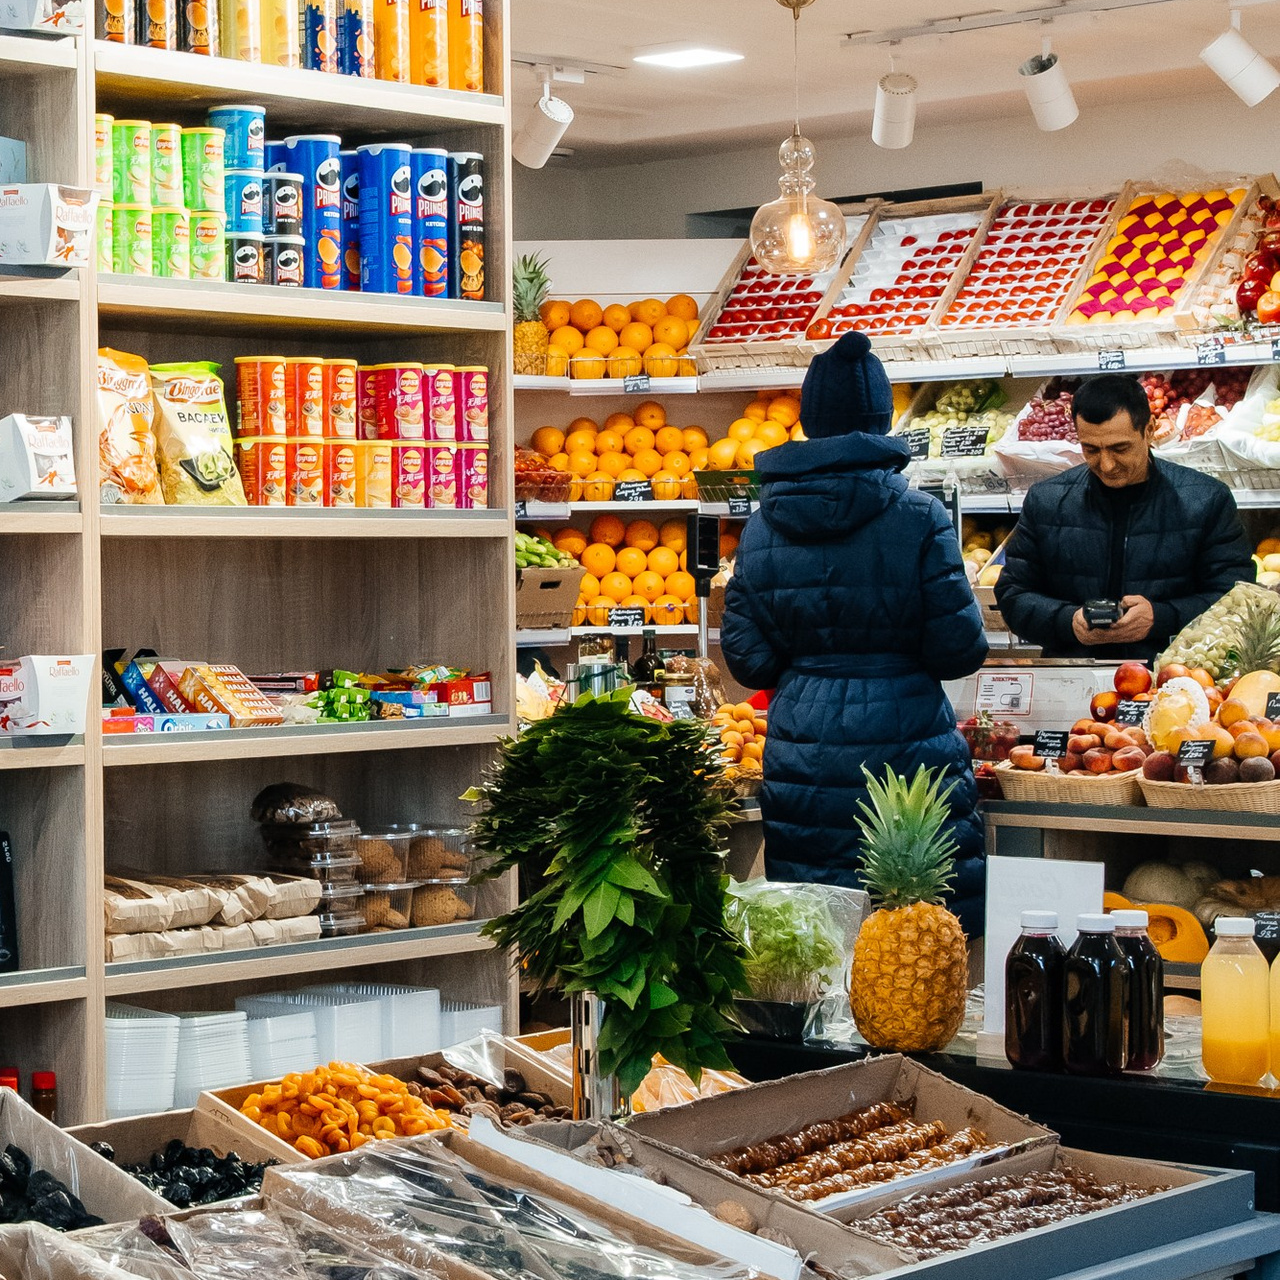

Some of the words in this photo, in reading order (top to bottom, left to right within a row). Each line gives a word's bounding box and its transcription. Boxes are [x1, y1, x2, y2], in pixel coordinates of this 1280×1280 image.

[55, 206, 93, 226] Raffaello
[27, 433, 70, 450] Raffaello
[49, 666, 80, 678] Raffaello
[234, 691, 261, 699] HALLS
[251, 708, 278, 716] HALLS
[161, 718, 194, 732] Orbit
